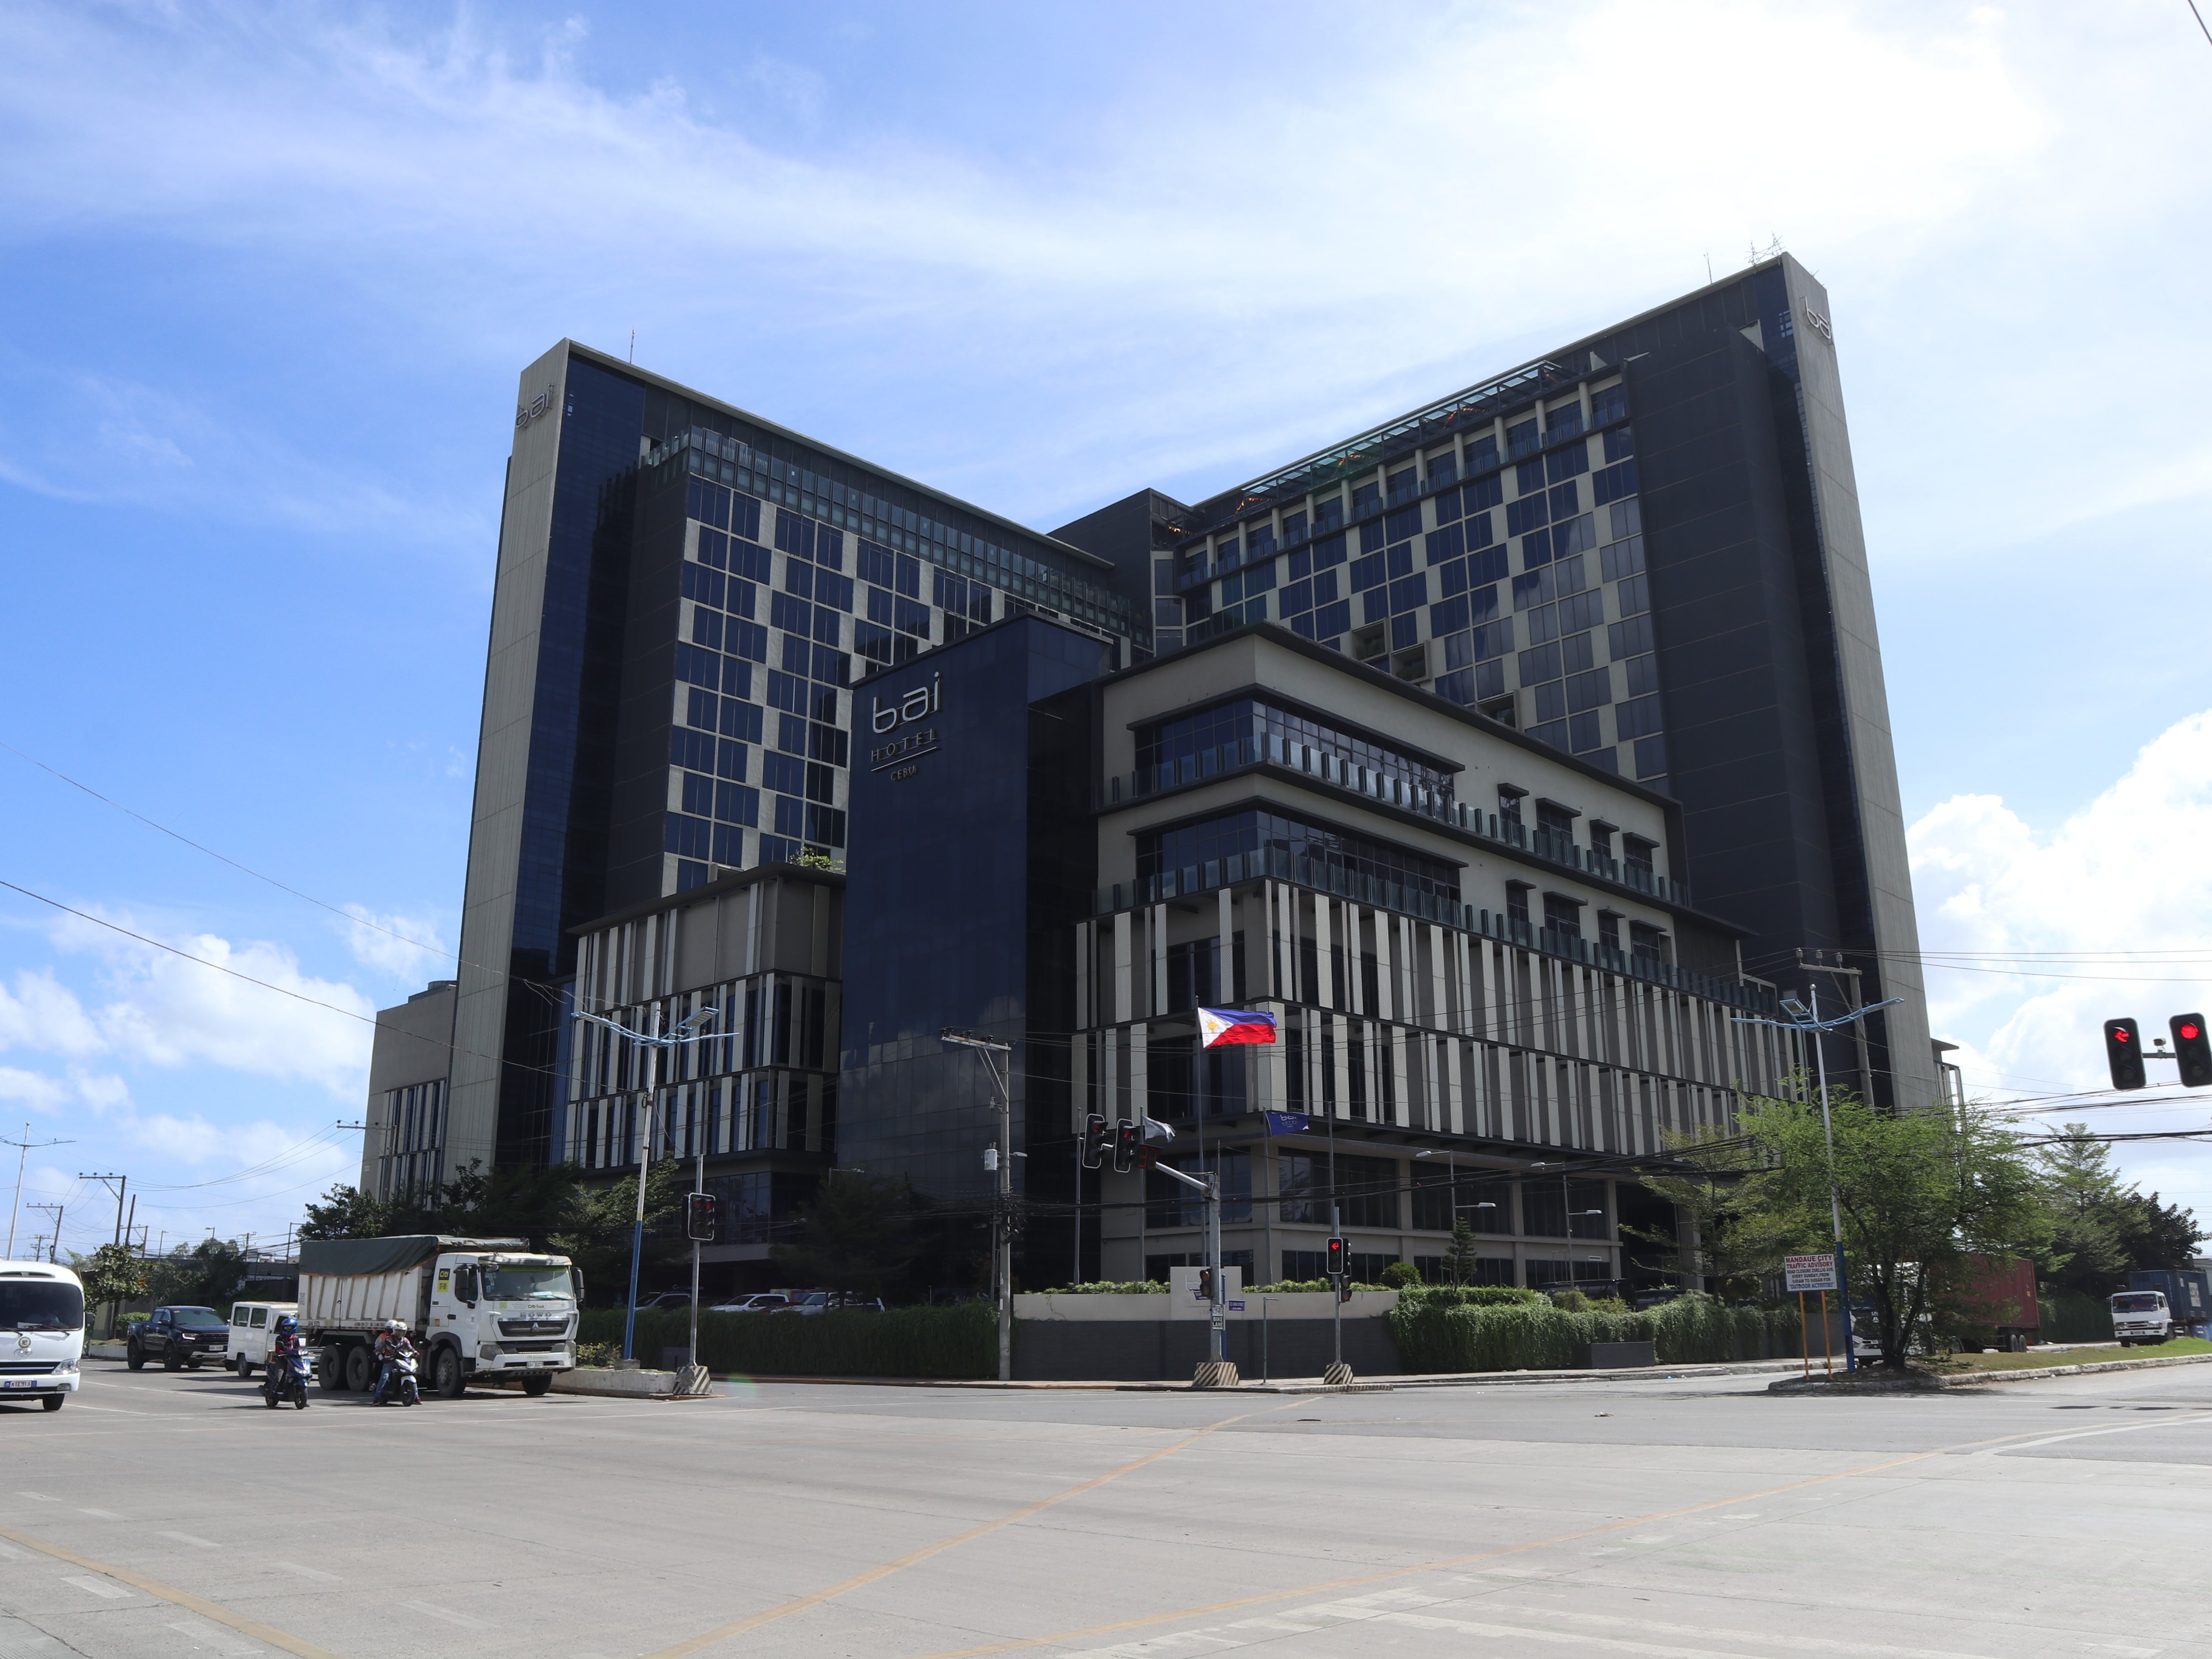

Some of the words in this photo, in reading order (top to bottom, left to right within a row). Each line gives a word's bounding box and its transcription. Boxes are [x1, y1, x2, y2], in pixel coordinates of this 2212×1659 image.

[1805, 296, 1835, 344] bai
[516, 382, 552, 428] bai
[872, 671, 941, 734] bai
[871, 728, 939, 763] HOTEL
[890, 765, 917, 781] CEBU
